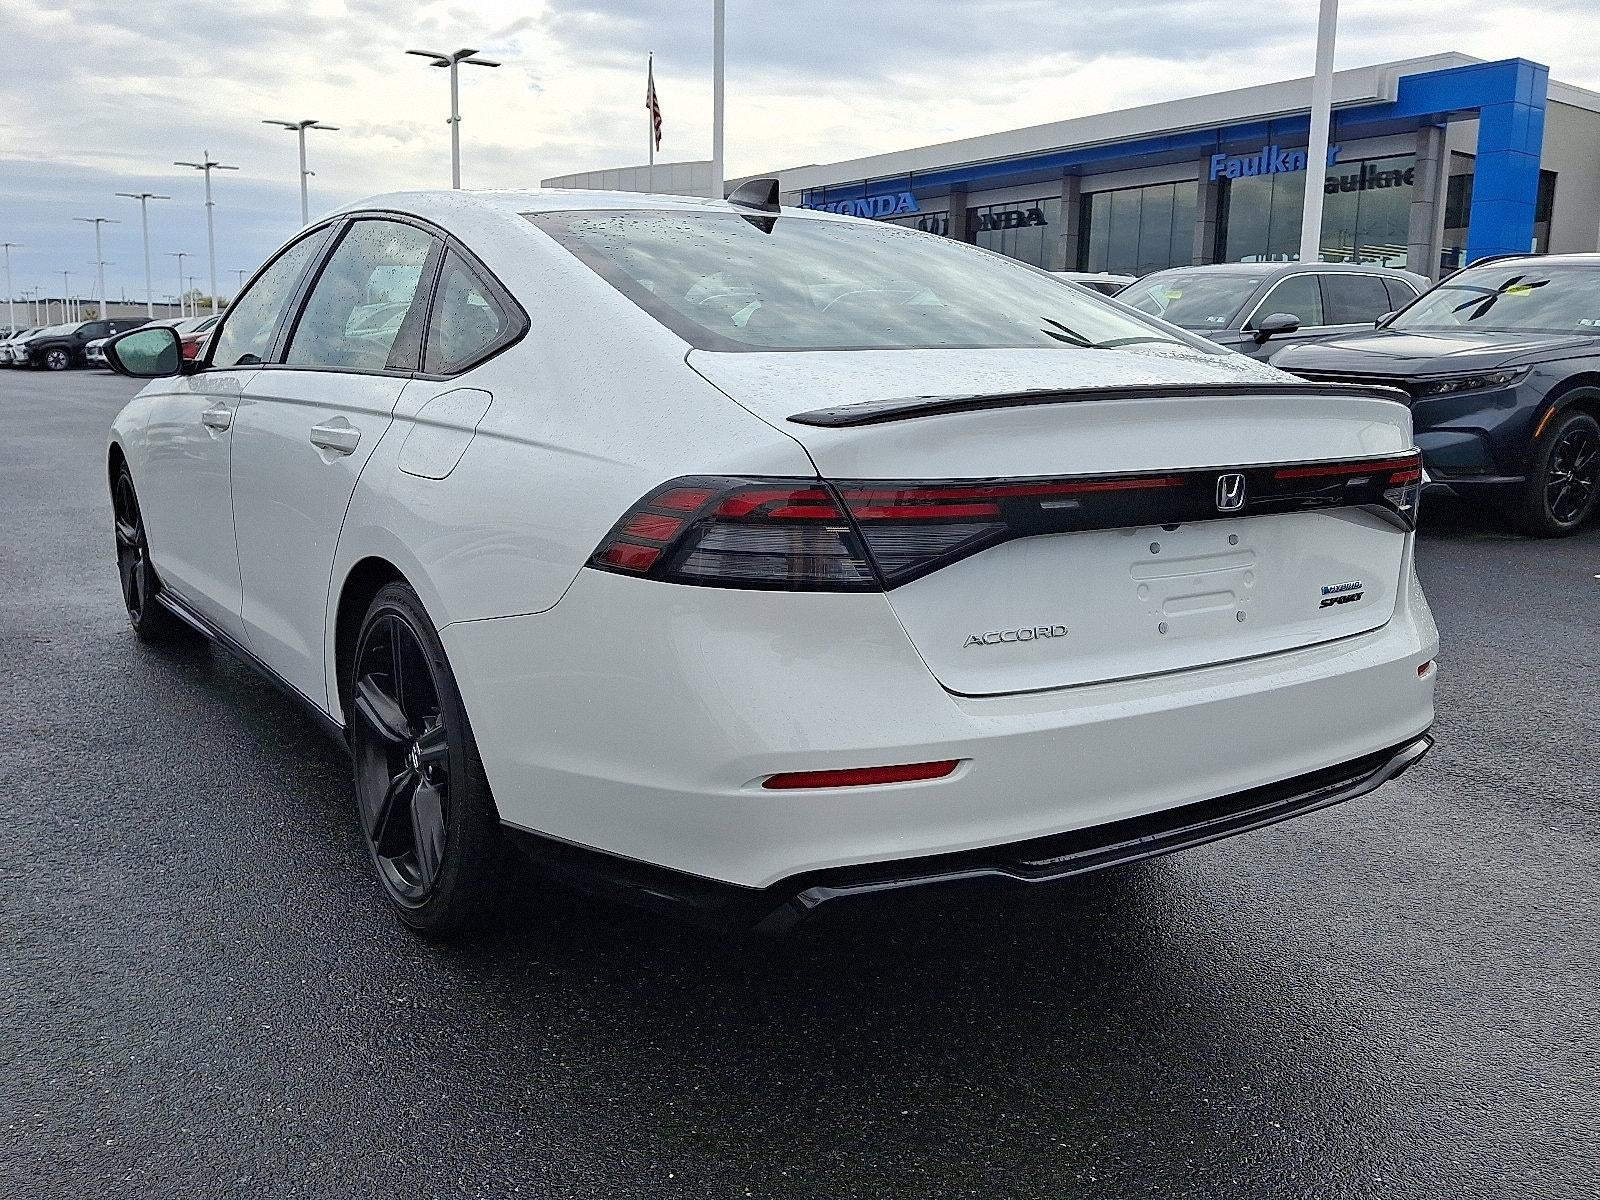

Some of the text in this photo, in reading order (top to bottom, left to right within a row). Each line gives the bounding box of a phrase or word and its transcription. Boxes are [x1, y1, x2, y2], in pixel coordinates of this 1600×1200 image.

[1210, 145, 1343, 181] Faulknr
[1325, 162, 1415, 195] aulkne
[1319, 591, 1364, 609] SPORT
[963, 624, 1069, 648] ACCORD
